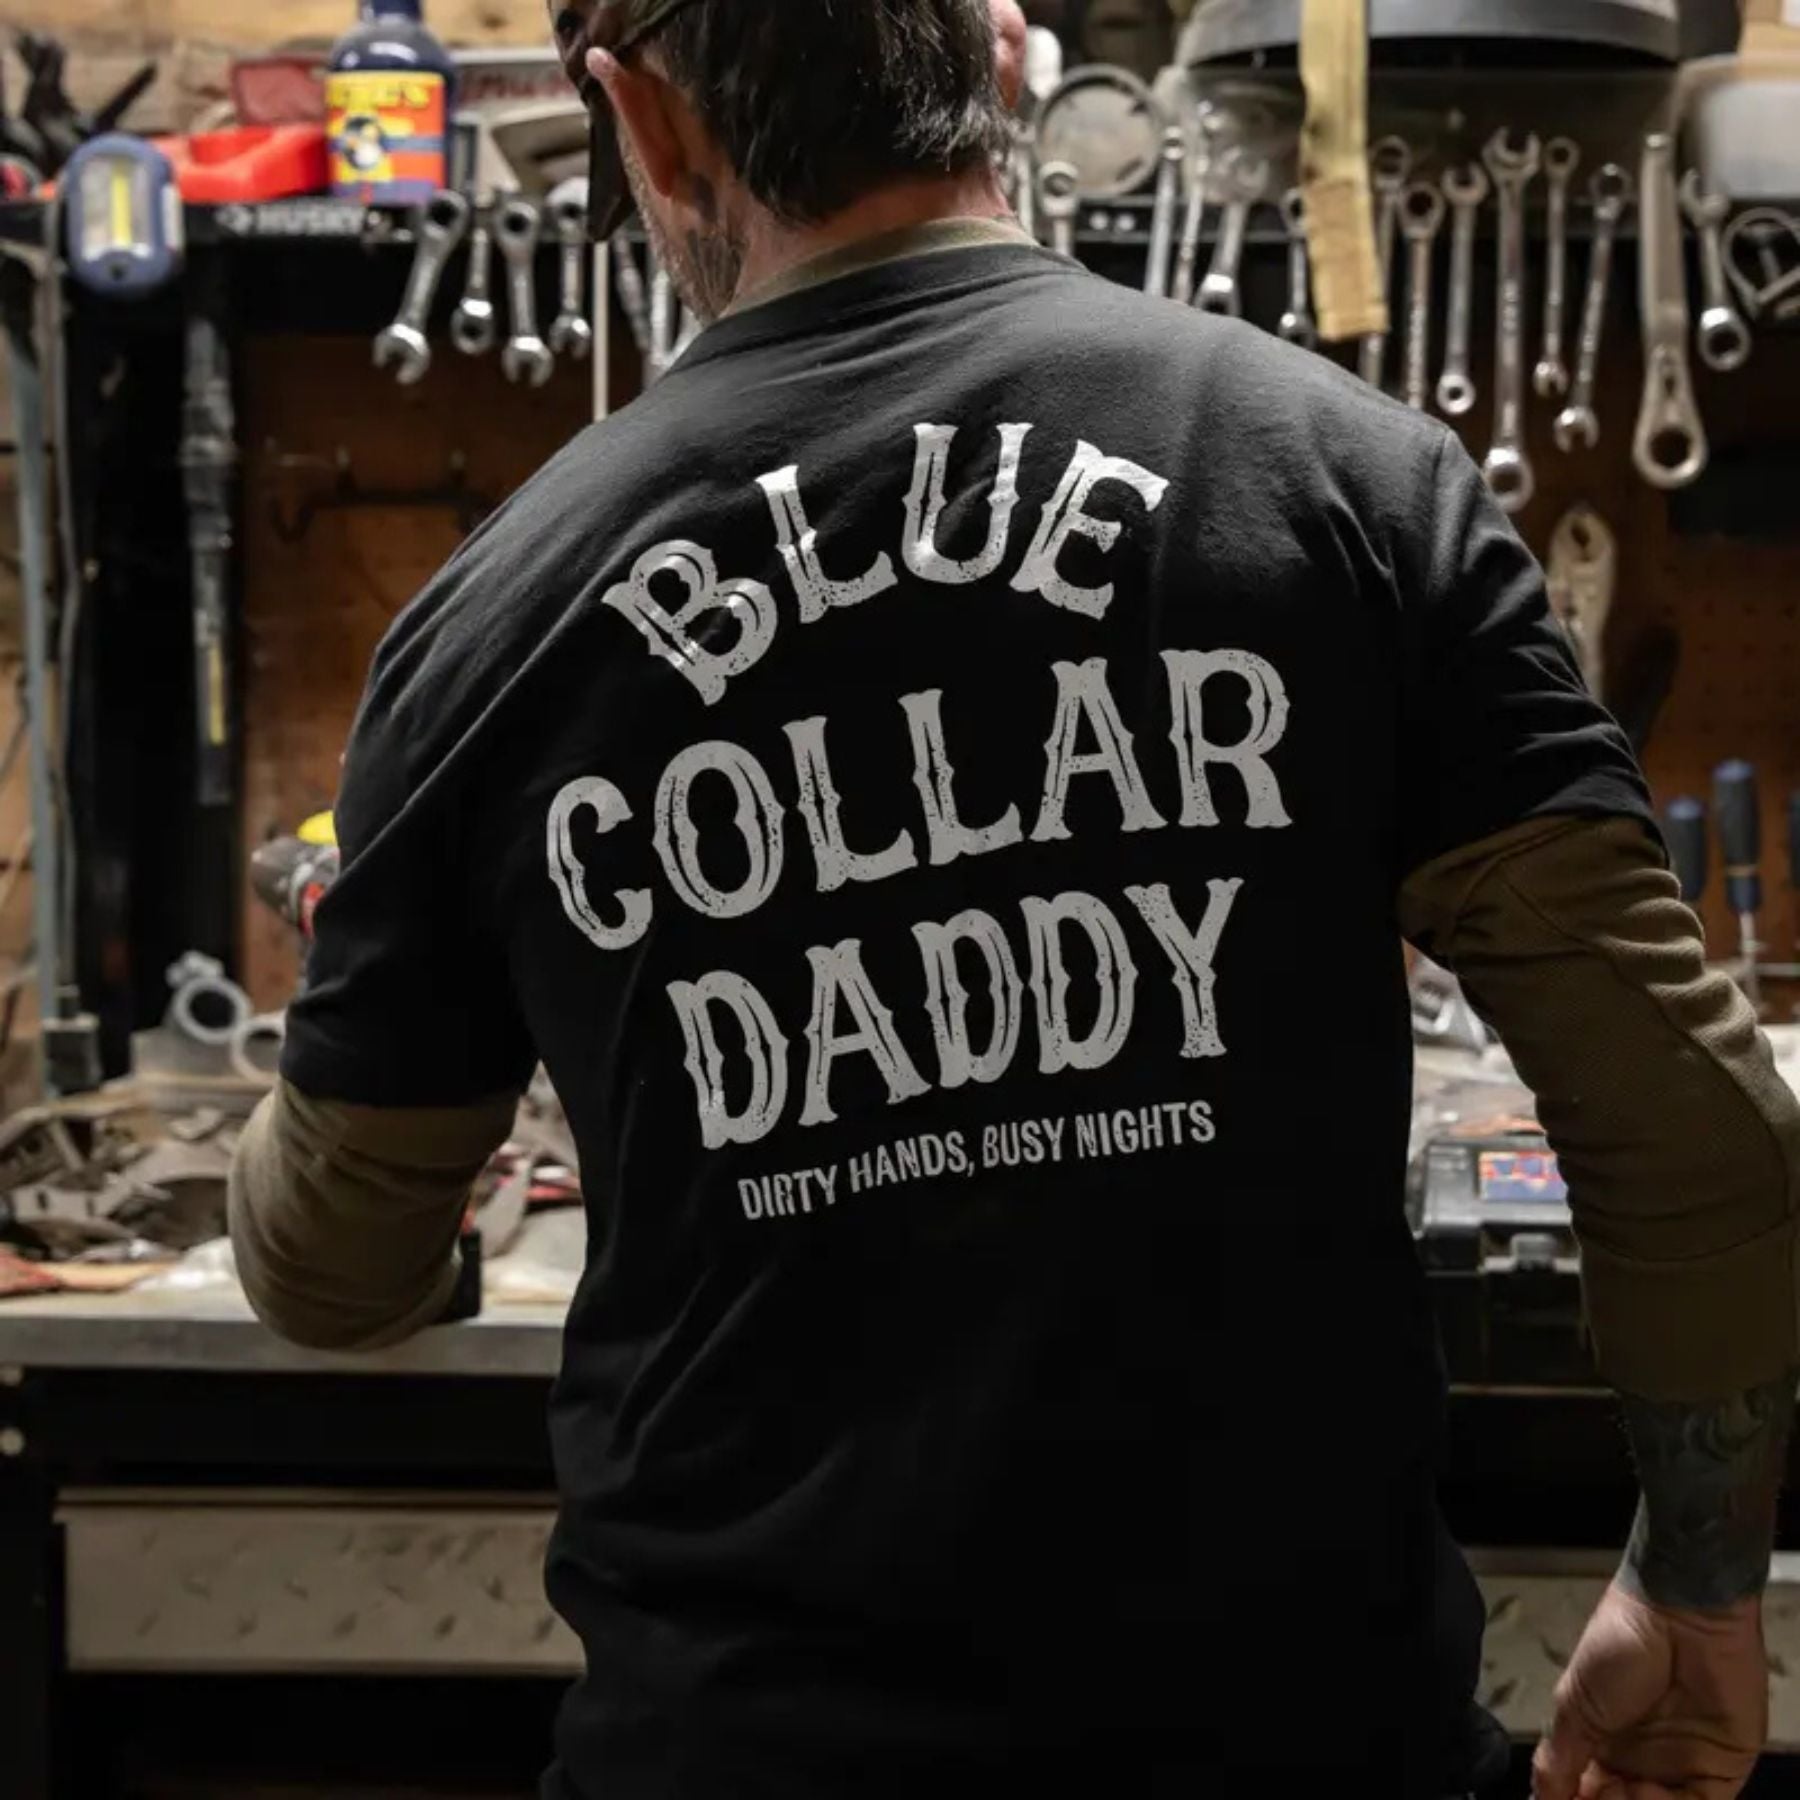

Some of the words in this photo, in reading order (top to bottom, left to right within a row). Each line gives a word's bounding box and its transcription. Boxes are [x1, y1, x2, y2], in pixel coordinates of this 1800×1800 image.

[601, 422, 1171, 706] BLUE
[546, 648, 1293, 950] COLLAR
[665, 877, 1244, 1149] DADDY
[737, 1165, 838, 1221] DIRTY
[849, 1131, 975, 1193] HANDS,
[982, 1117, 1066, 1168] BUSY
[1075, 1100, 1216, 1158] NIGHTS
